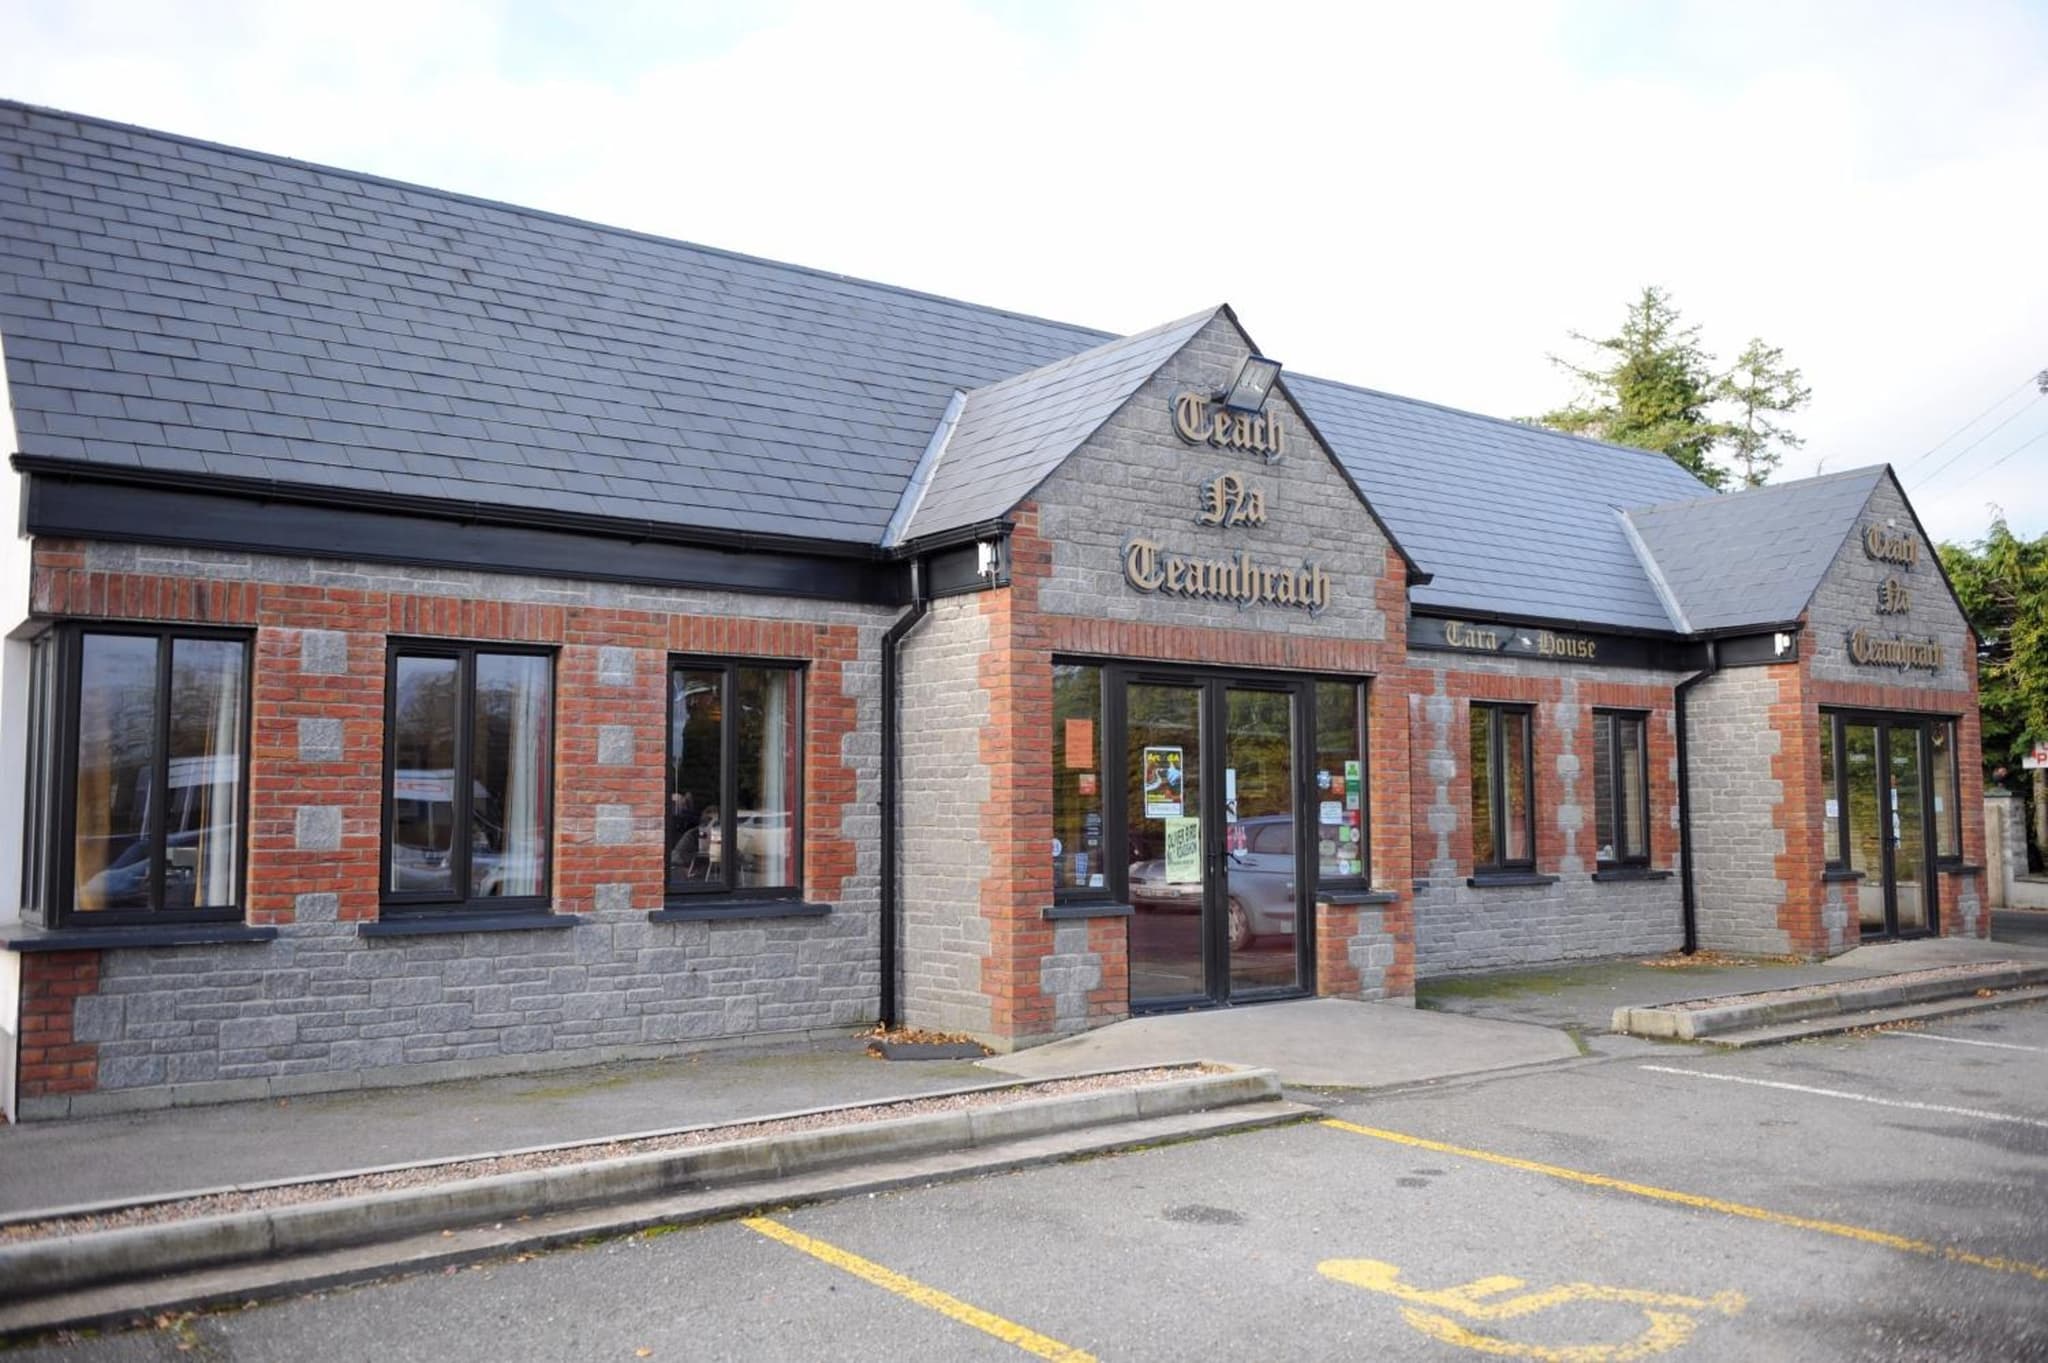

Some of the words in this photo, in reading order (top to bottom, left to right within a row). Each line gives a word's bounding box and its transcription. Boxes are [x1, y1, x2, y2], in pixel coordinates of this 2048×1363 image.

[1170, 389, 1286, 462] Teach
[1197, 471, 1267, 527] Na
[1121, 537, 1330, 618] Teamhrach
[1445, 620, 1497, 650] Tara
[1538, 630, 1596, 659] House
